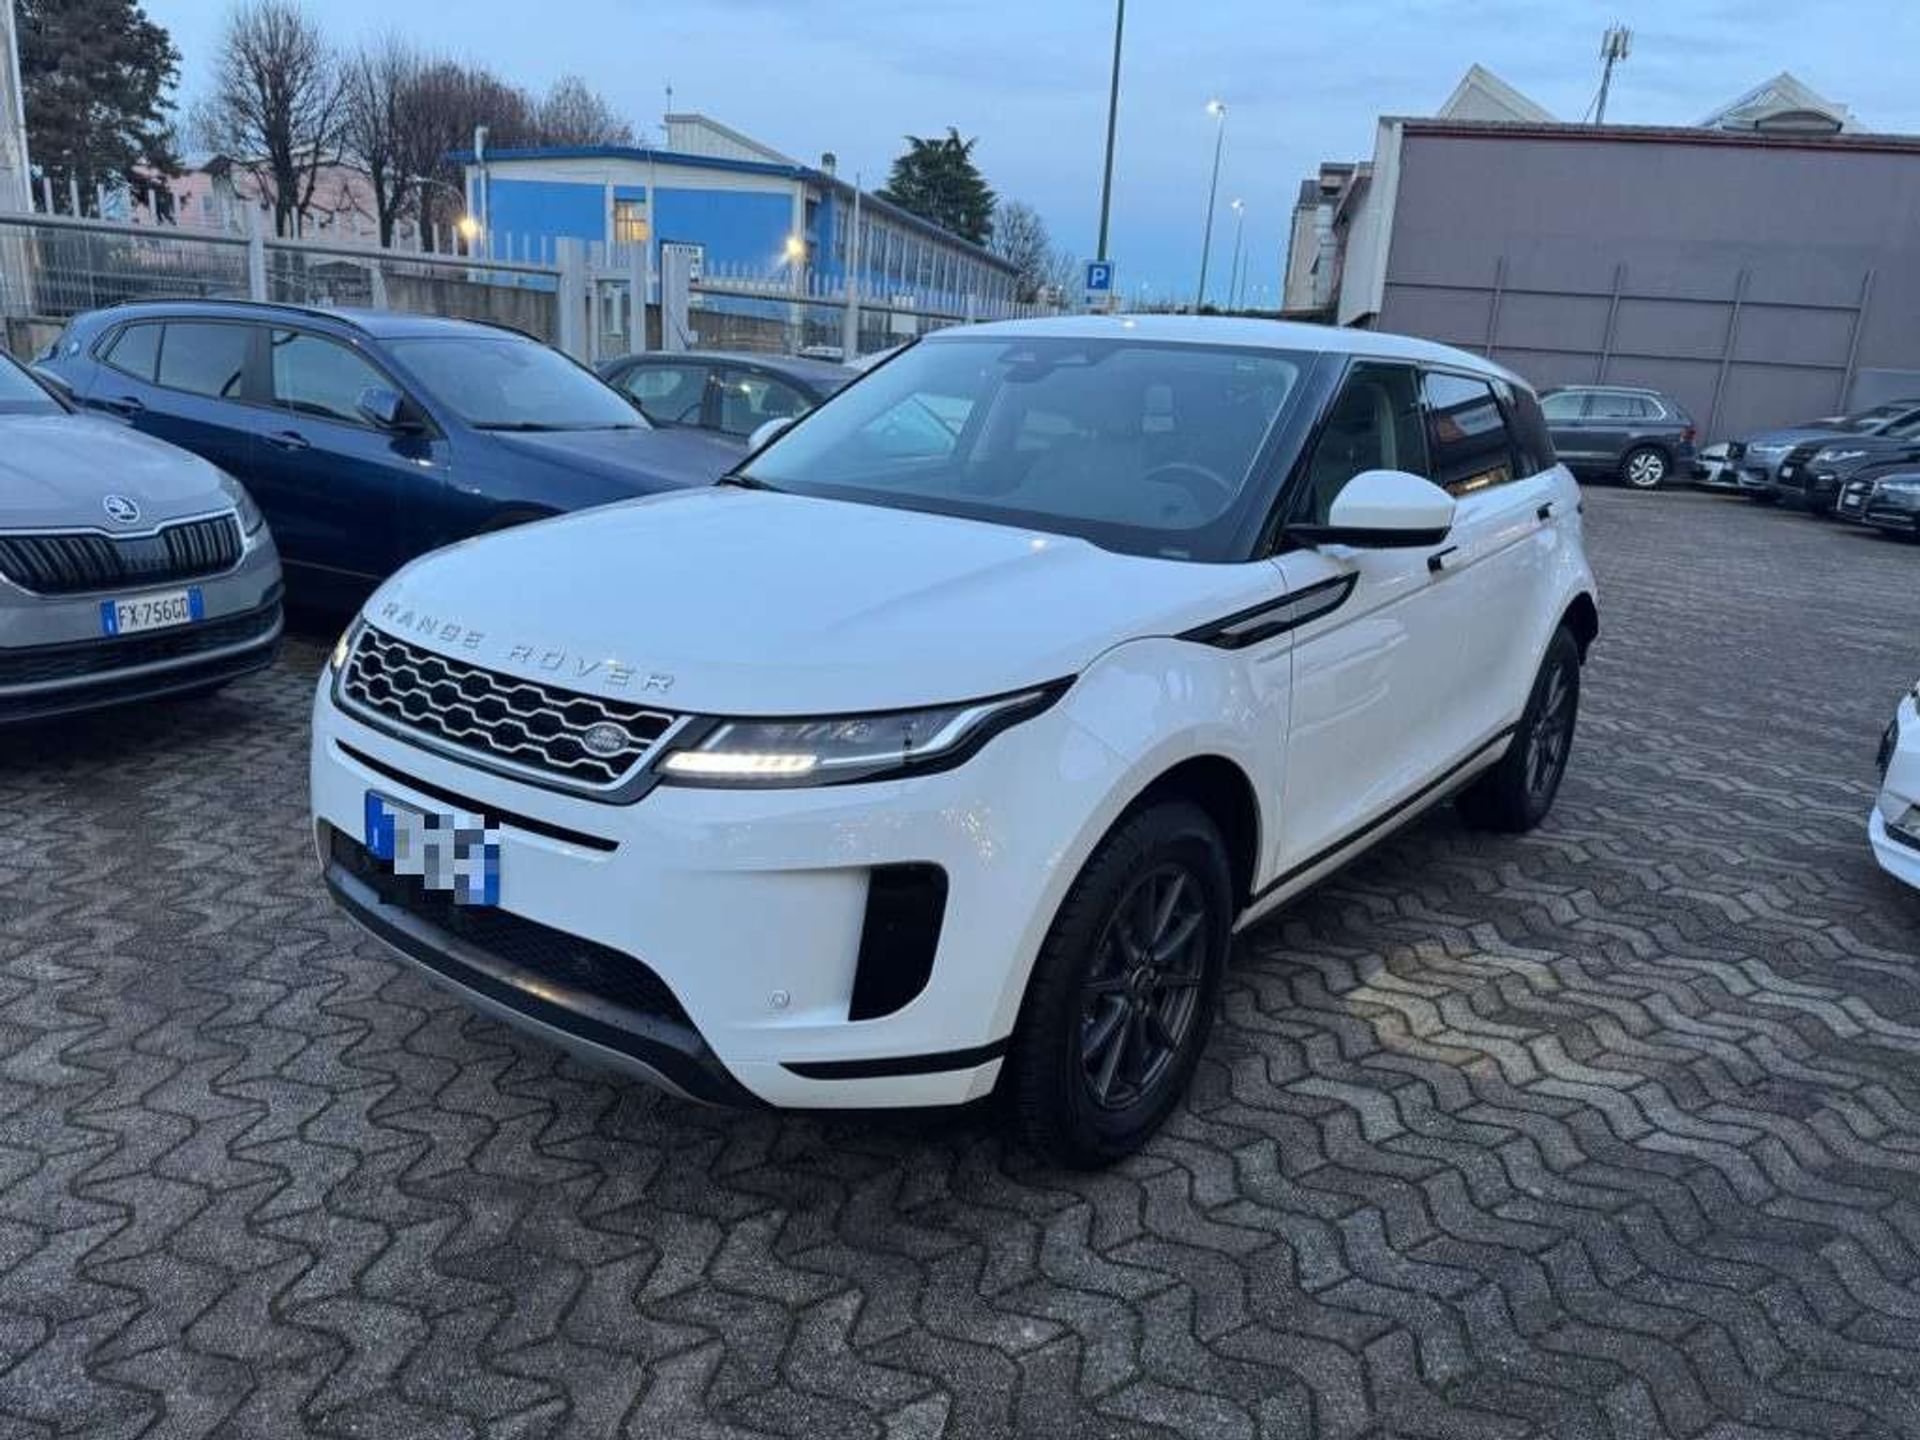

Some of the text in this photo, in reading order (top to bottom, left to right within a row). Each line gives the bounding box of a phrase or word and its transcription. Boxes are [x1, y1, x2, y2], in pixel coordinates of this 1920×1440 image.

[1091, 267, 1106, 286] P
[381, 602, 675, 694] RANGE ROVER
